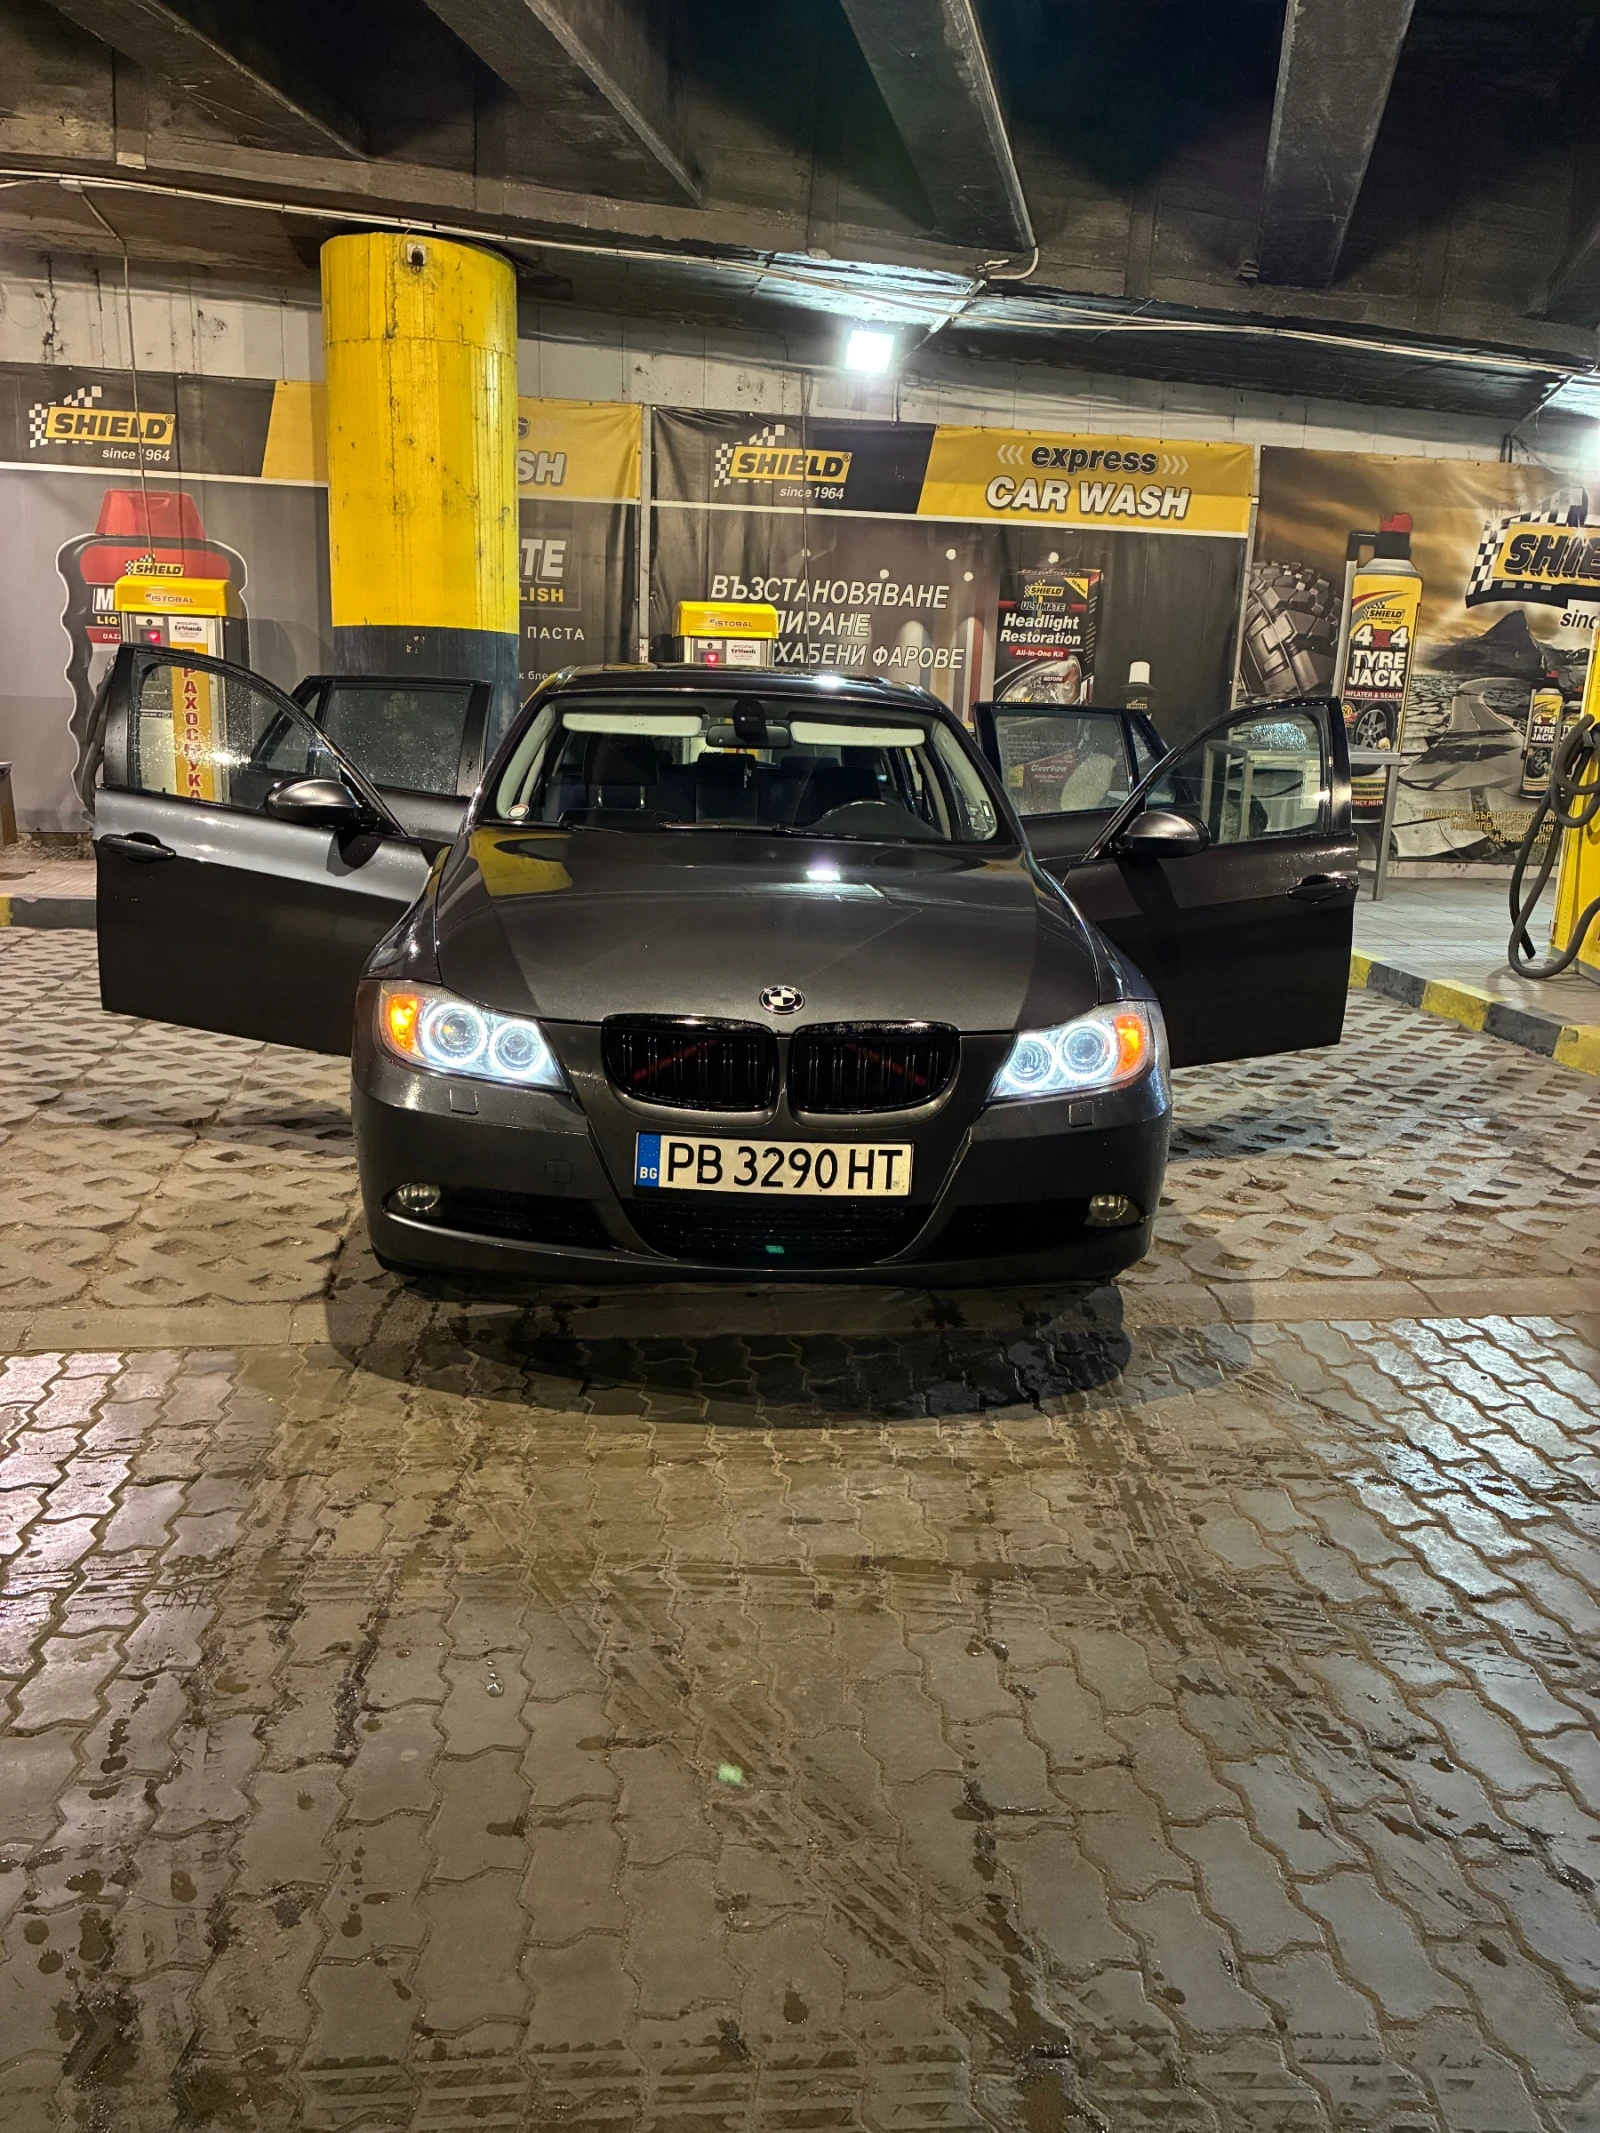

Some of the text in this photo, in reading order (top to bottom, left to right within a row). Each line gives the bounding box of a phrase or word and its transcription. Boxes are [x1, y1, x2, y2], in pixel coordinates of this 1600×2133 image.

[102, 447, 171, 461] since 964
[1031, 445, 1158, 474] express
[518, 450, 566, 485] SH
[780, 486, 845, 499] since 1964
[985, 475, 1192, 519] CAR WASH
[520, 538, 567, 578] TE
[1504, 533, 1600, 578] SHIE
[135, 563, 182, 575] SHIELD
[519, 587, 564, 603] LISH
[711, 575, 950, 609] ВЪЗСТАНОВЯВАНЕ
[1031, 586, 1062, 595] SHIELD
[1021, 601, 1066, 612] ULTIMATE
[1369, 609, 1403, 618] SHIELD
[97, 616, 119, 626] LIQ
[778, 610, 871, 637] ИРАНЕ
[1004, 612, 1080, 631] Headlight
[1560, 609, 1597, 630] sinc
[527, 626, 585, 640] ПАСТА
[1000, 629, 1081, 645] Restoration
[773, 641, 965, 670] ХАБЕНИ ФАРОВЕ
[1052, 650, 1065, 658] Kit
[1353, 649, 1406, 669] TYRE
[1348, 667, 1404, 688] JACK
[1380, 691, 1403, 699] SEALER
[1531, 733, 1554, 742] JACK
[1534, 726, 1556, 734] TYRE
[639, 1142, 903, 1191] BG PB 3290 HT
